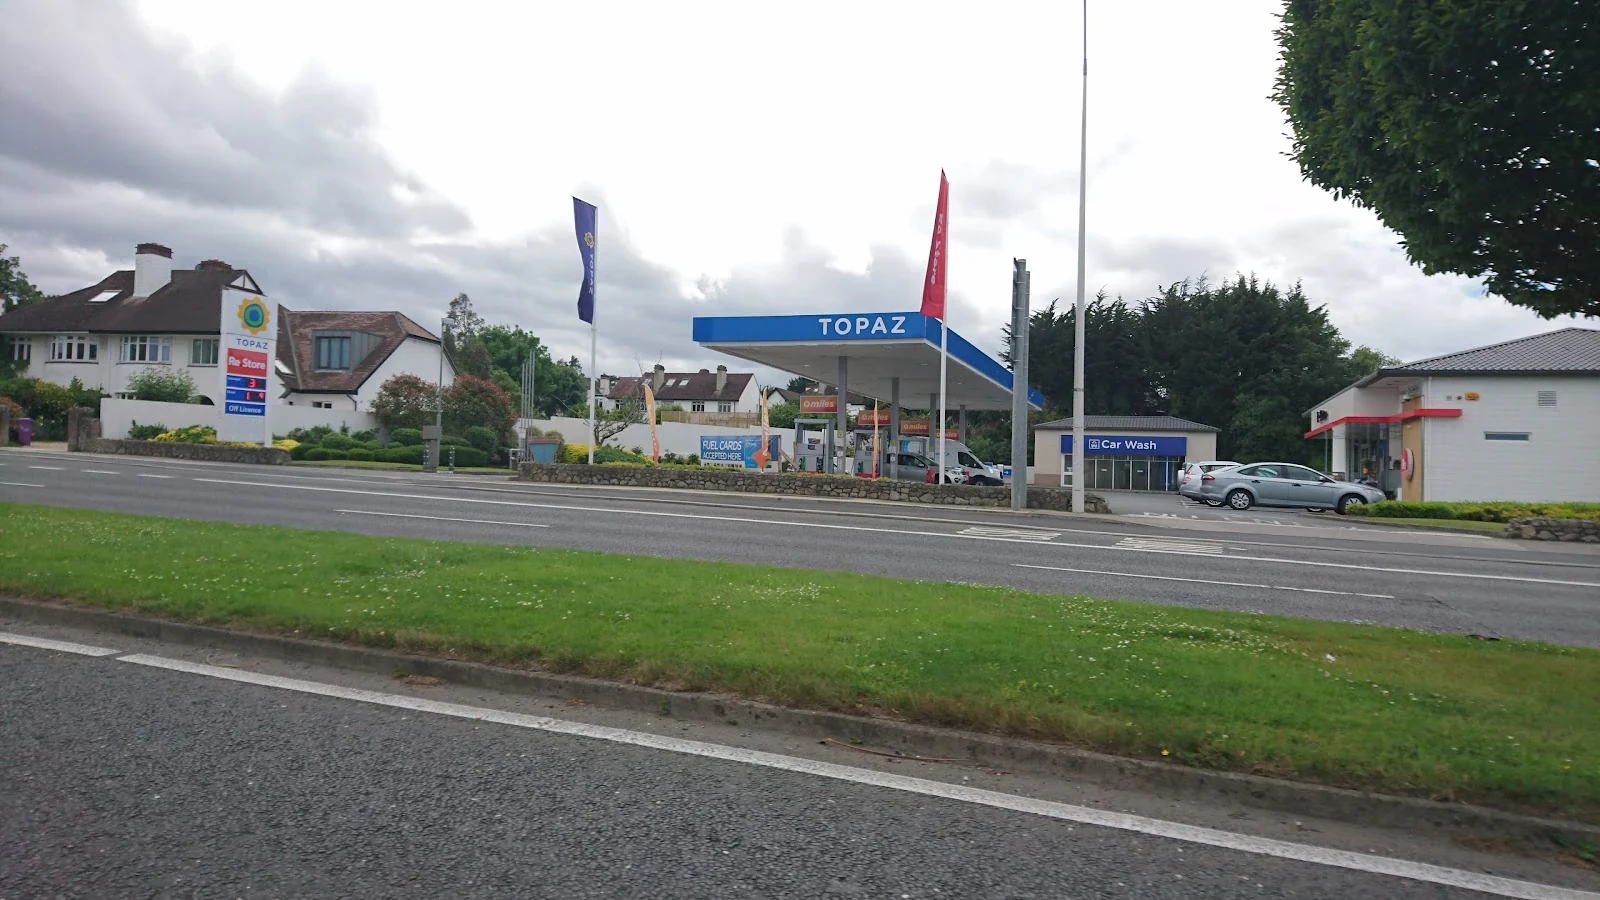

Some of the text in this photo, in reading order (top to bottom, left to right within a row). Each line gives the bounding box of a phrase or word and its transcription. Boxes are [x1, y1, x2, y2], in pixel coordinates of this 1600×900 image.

[818, 316, 906, 335] TOPAZ
[236, 338, 268, 349] TOPAZ
[702, 440, 718, 450] FUEL
[719, 440, 742, 450] CARDS
[1101, 440, 1157, 450] Car Wash
[703, 452, 728, 460] ACCEPTED
[727, 452, 742, 460] HERE
